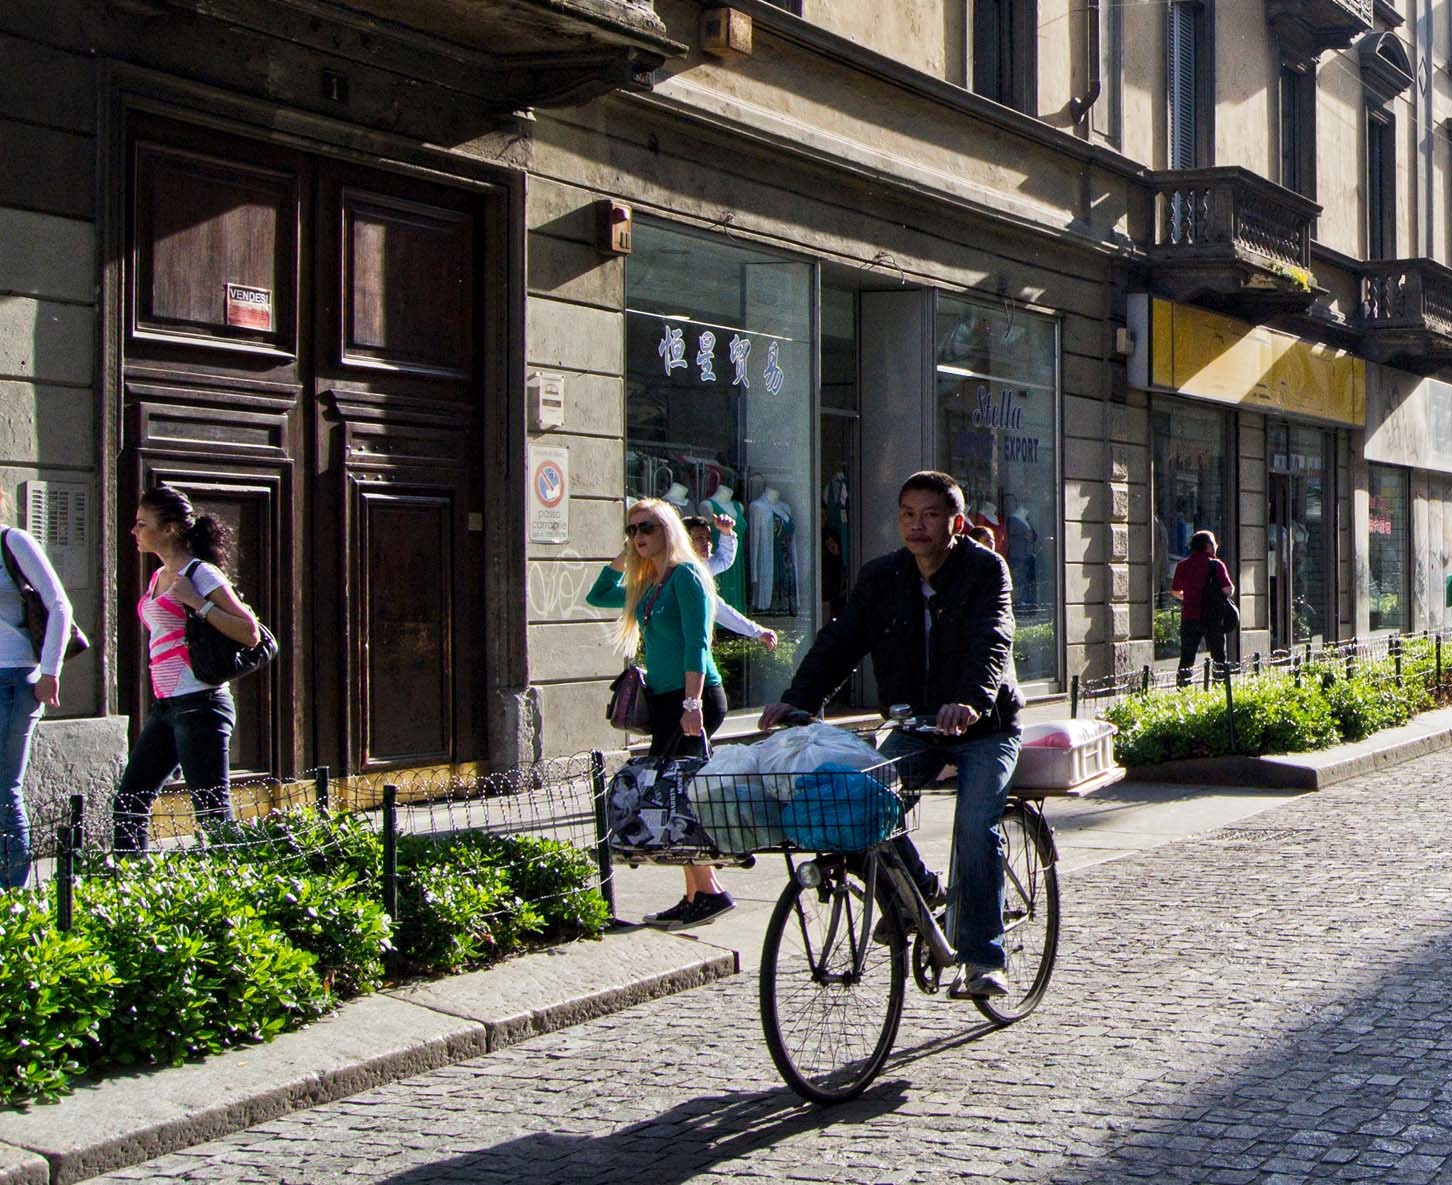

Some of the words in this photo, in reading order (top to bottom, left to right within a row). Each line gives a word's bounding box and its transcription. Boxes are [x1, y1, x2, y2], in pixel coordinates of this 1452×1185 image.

[230, 288, 269, 304] VENDESI
[658, 324, 785, 396] 恒星贸易
[971, 383, 1023, 431] Stella
[1004, 435, 1039, 463] EXPORT
